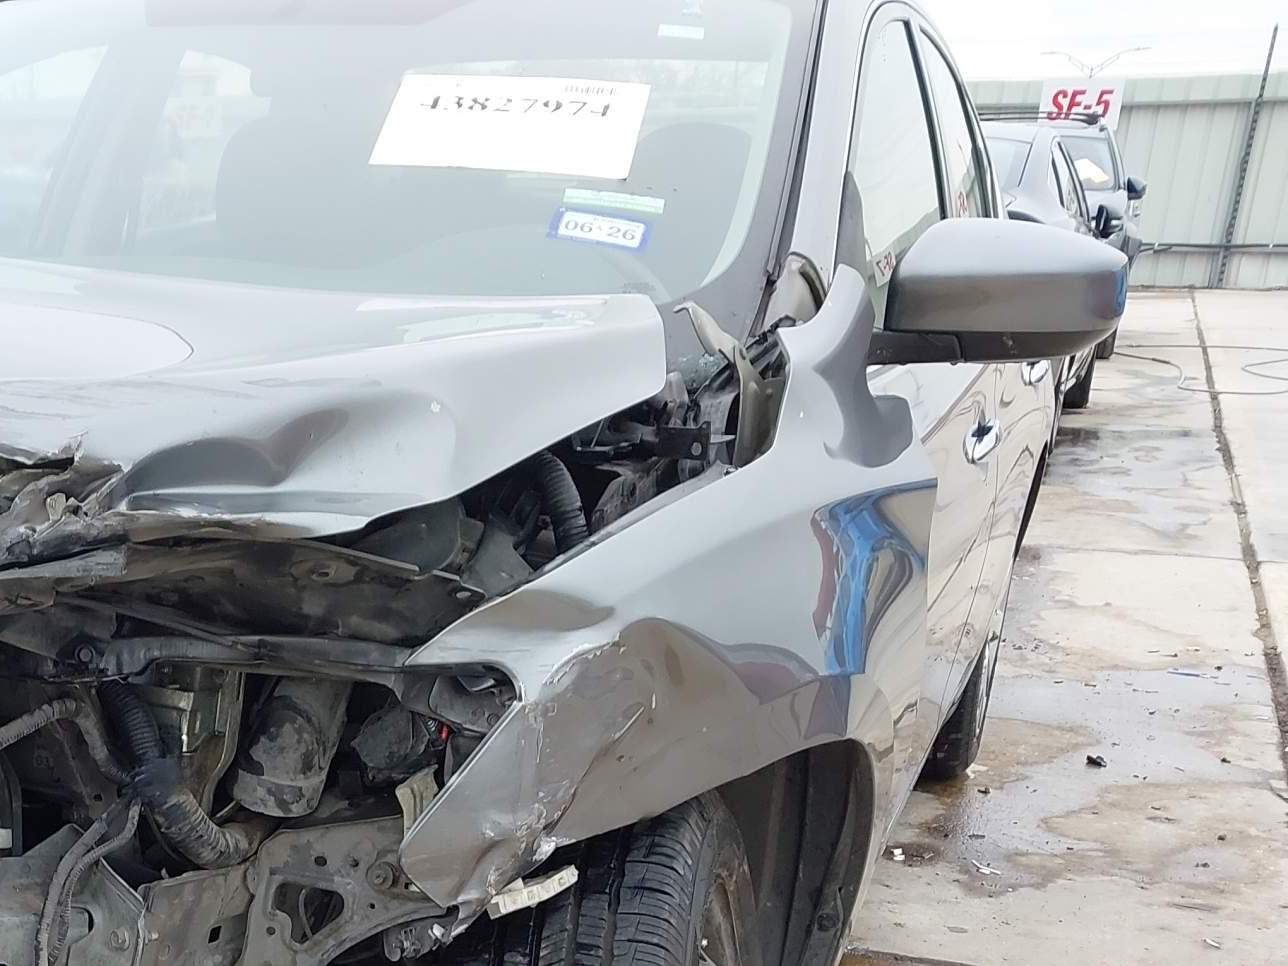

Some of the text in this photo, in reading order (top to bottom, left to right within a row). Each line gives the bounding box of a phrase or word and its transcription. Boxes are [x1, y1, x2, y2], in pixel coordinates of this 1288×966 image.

[419, 95, 611, 117] 43827974
[564, 219, 594, 234] 06
[607, 225, 637, 241] 26
